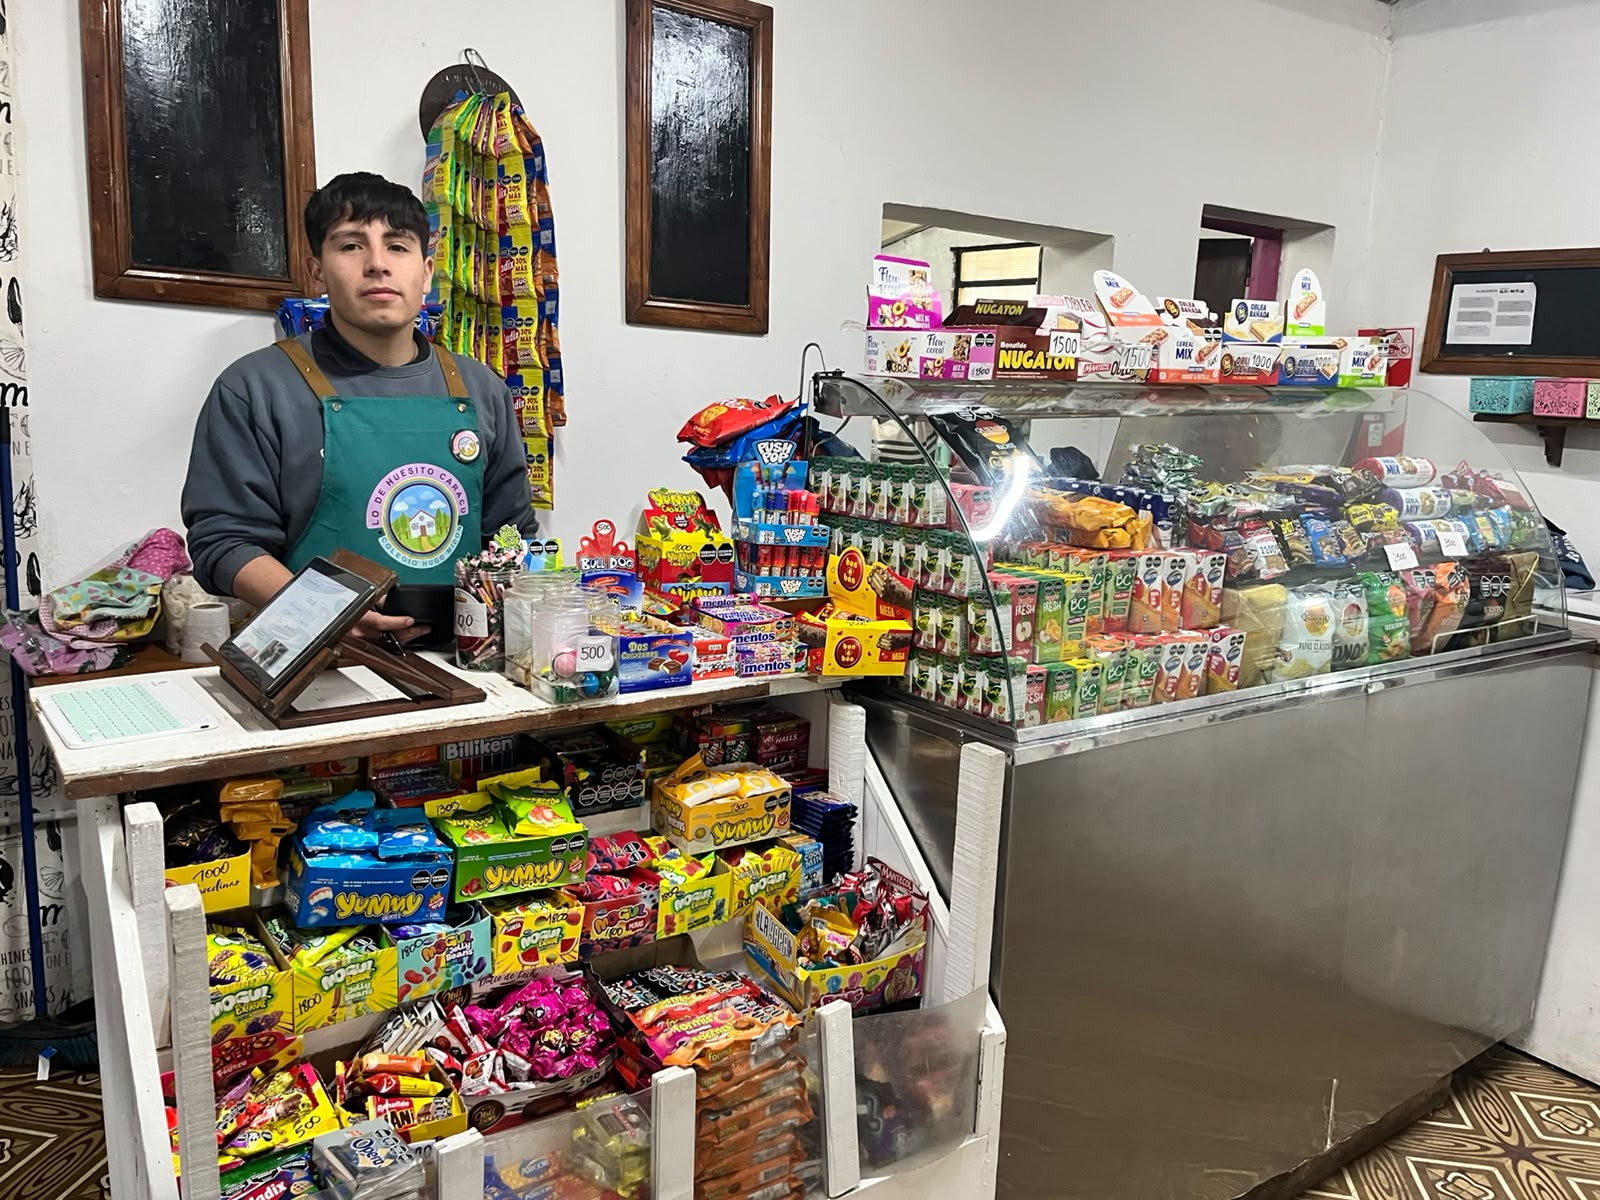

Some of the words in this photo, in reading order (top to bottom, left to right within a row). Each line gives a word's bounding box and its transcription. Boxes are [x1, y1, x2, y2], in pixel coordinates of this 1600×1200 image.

[1302, 282, 1311, 290] MIX
[975, 303, 1024, 316] NUGATON
[1064, 297, 1095, 312] OBLEA
[927, 334, 945, 346] Flow
[1053, 336, 1077, 354] 1500
[998, 350, 1075, 370] NUGATON
[1124, 348, 1150, 368] 1500
[1176, 348, 1193, 360] MIX
[1236, 357, 1250, 366] OBL
[1252, 355, 1272, 368] 1000
[1315, 356, 1331, 366] 1000
[1352, 358, 1365, 367] MIX
[756, 442, 794, 454] PUSH
[762, 451, 788, 464] POP
[1386, 464, 1400, 475] MIX
[386, 467, 434, 486] HUESITO
[374, 488, 386, 504] DE
[649, 491, 701, 505] YUMMY
[1406, 505, 1420, 514] MIX
[372, 510, 379, 526] LO
[784, 528, 806, 538] PUSH
[790, 534, 804, 543] POP
[381, 538, 417, 566] COLEGIO
[422, 555, 446, 566] HUGO
[580, 557, 605, 570] BULL
[609, 557, 635, 569] DOG
[845, 559, 858, 569] bon
[780, 579, 802, 588] PUSH
[843, 574, 856, 584] bon
[1116, 574, 1131, 586] BC
[786, 586, 800, 594] POP
[702, 598, 736, 608] mentos
[1043, 601, 1061, 612] FRESH
[1070, 598, 1086, 611] BC
[879, 603, 896, 618] MEGA
[1016, 605, 1034, 616] FRESH
[732, 632, 775, 644] mentos
[581, 646, 605, 659] 500
[628, 642, 648, 652] Dos
[1299, 642, 1313, 650] PAPAS
[892, 652, 906, 660] MEGA
[743, 659, 791, 674] mentos
[1108, 665, 1123, 678] BC
[1142, 662, 1157, 673] BC
[1053, 689, 1072, 701] FRESH
[1081, 684, 1097, 697] BC
[775, 735, 797, 743] HALLS
[446, 738, 514, 760] Billiken
[436, 802, 460, 815] 1300
[730, 802, 749, 812] 1300
[712, 813, 775, 845] YUMMY
[193, 862, 229, 881] 1000
[484, 858, 565, 891] YUMMY
[749, 872, 788, 895] MOGUL
[335, 892, 423, 918] YUMMY
[674, 889, 713, 911] MOGUL
[546, 912, 568, 925] 1800
[594, 903, 647, 934] MOGUL
[628, 921, 643, 931] MORAS
[520, 928, 562, 946] MOGUL
[401, 938, 423, 959] 1800
[421, 930, 474, 962] MOGUL
[447, 940, 474, 954] Jelly
[445, 948, 474, 962] Beans
[320, 959, 376, 991] MOGUL
[479, 975, 504, 988] Dulce
[506, 974, 516, 982] de
[517, 969, 539, 982] Leche
[348, 982, 372, 995] Jelly
[344, 989, 373, 1002] Beans
[210, 986, 272, 1021] MOGUL
[298, 993, 322, 1016] 1800
[708, 1048, 732, 1062] formis
[579, 1071, 601, 1086] 500
[294, 1116, 320, 1138] 500
[352, 1138, 383, 1166] Opera
